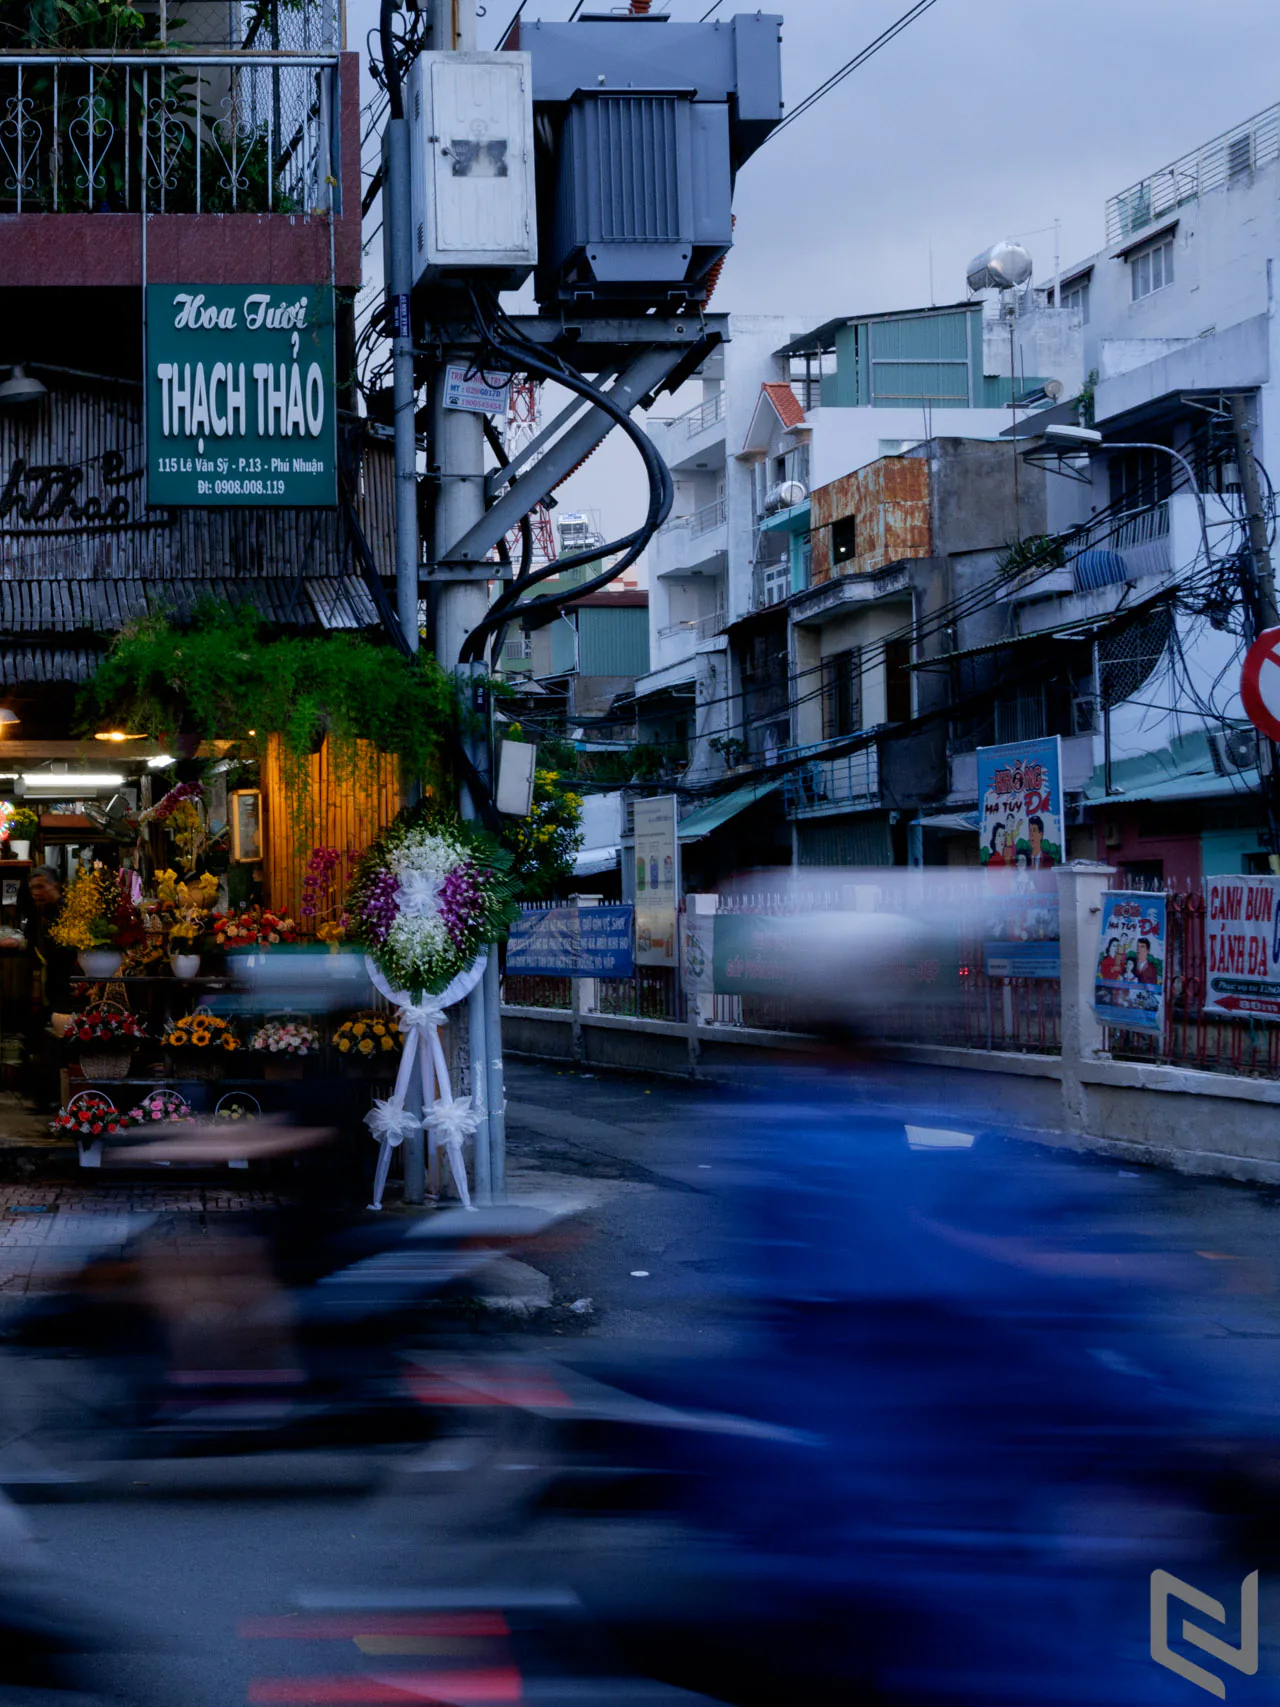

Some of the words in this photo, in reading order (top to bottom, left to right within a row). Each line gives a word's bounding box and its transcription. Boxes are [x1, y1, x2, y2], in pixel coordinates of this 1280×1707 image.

[172, 293, 238, 330] Hoa
[156, 361, 247, 456] THẠCH
[252, 330, 325, 438] THẢO
[157, 457, 178, 473] 115
[180, 457, 193, 473] Lê
[216, 458, 229, 475] Sỹ
[238, 457, 262, 473] P.13
[271, 457, 290, 473] Phú
[292, 457, 324, 476] Nhuận
[214, 479, 285, 495] 0908.008.119
[1211, 886, 1244, 920] CANH
[1245, 880, 1274, 922] BÚN
[1248, 935, 1269, 977] ĐA
